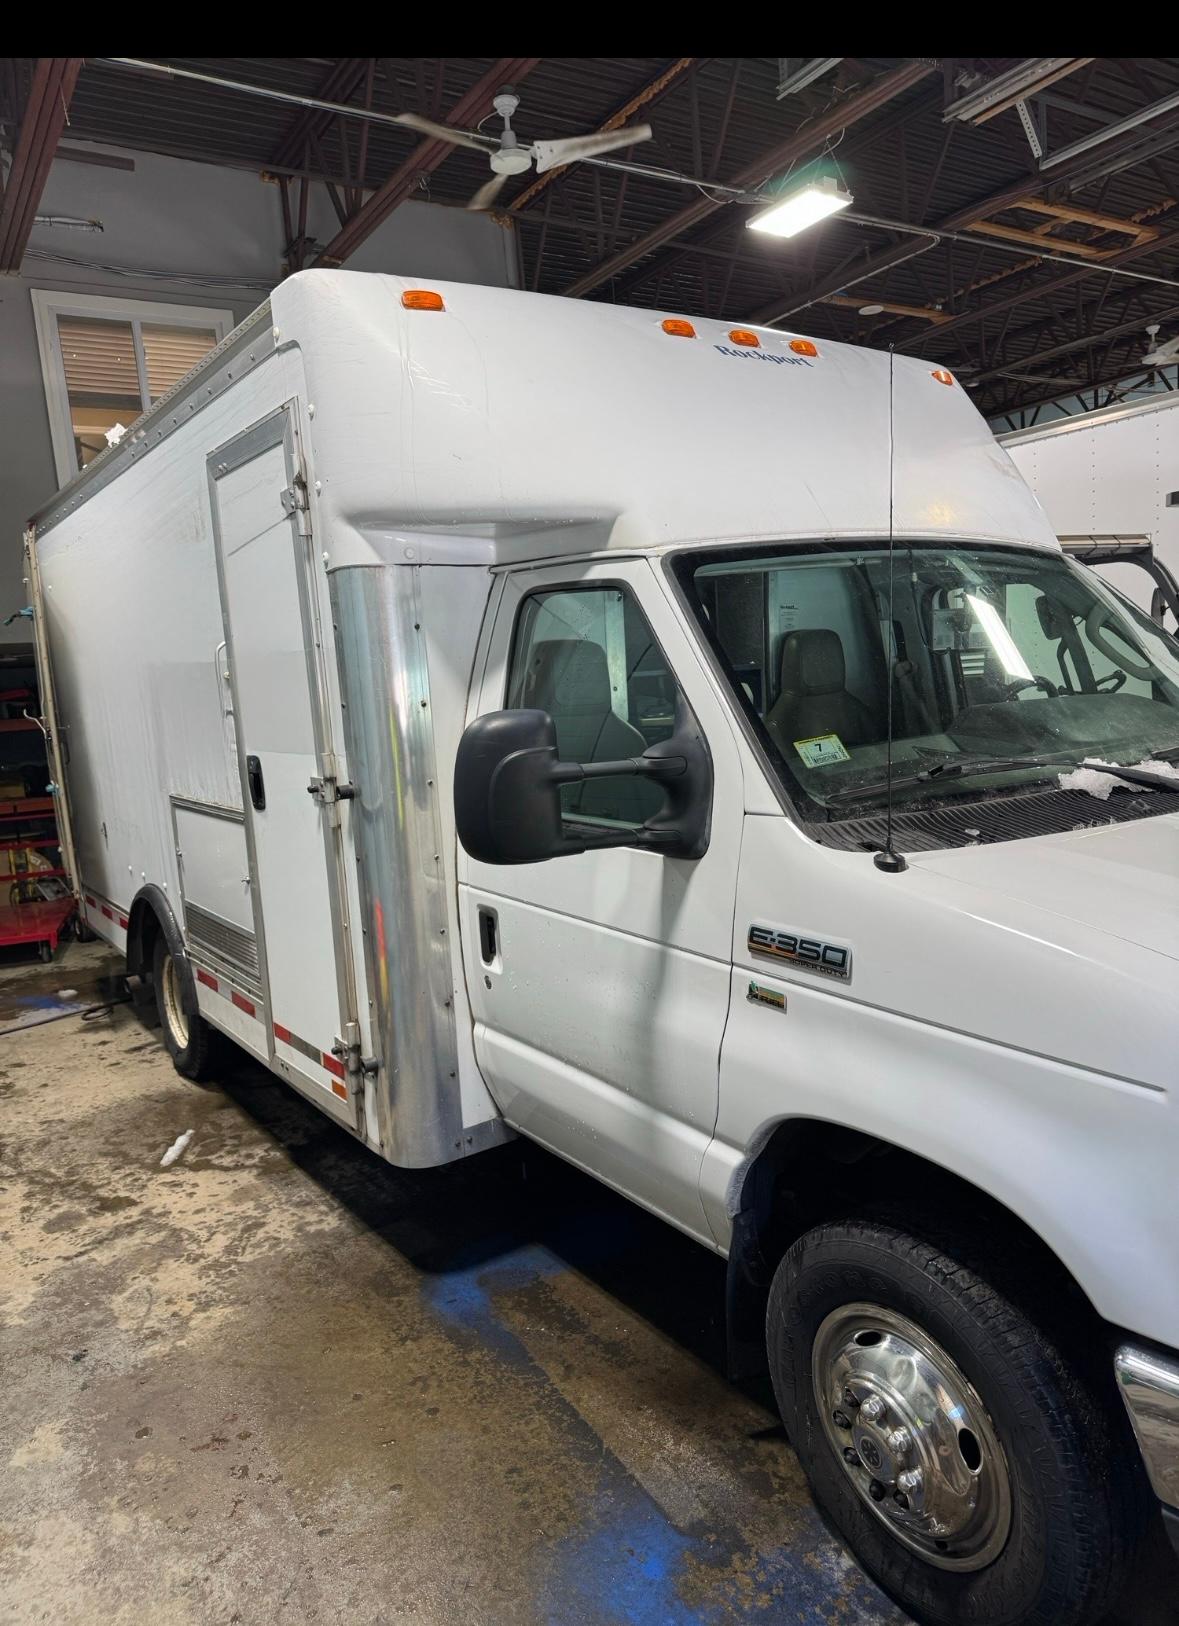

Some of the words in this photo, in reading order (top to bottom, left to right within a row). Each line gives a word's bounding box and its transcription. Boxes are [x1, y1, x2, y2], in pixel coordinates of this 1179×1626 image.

[713, 344, 814, 368] Rockport
[814, 743, 822, 752] 7
[749, 926, 848, 968] E-350
